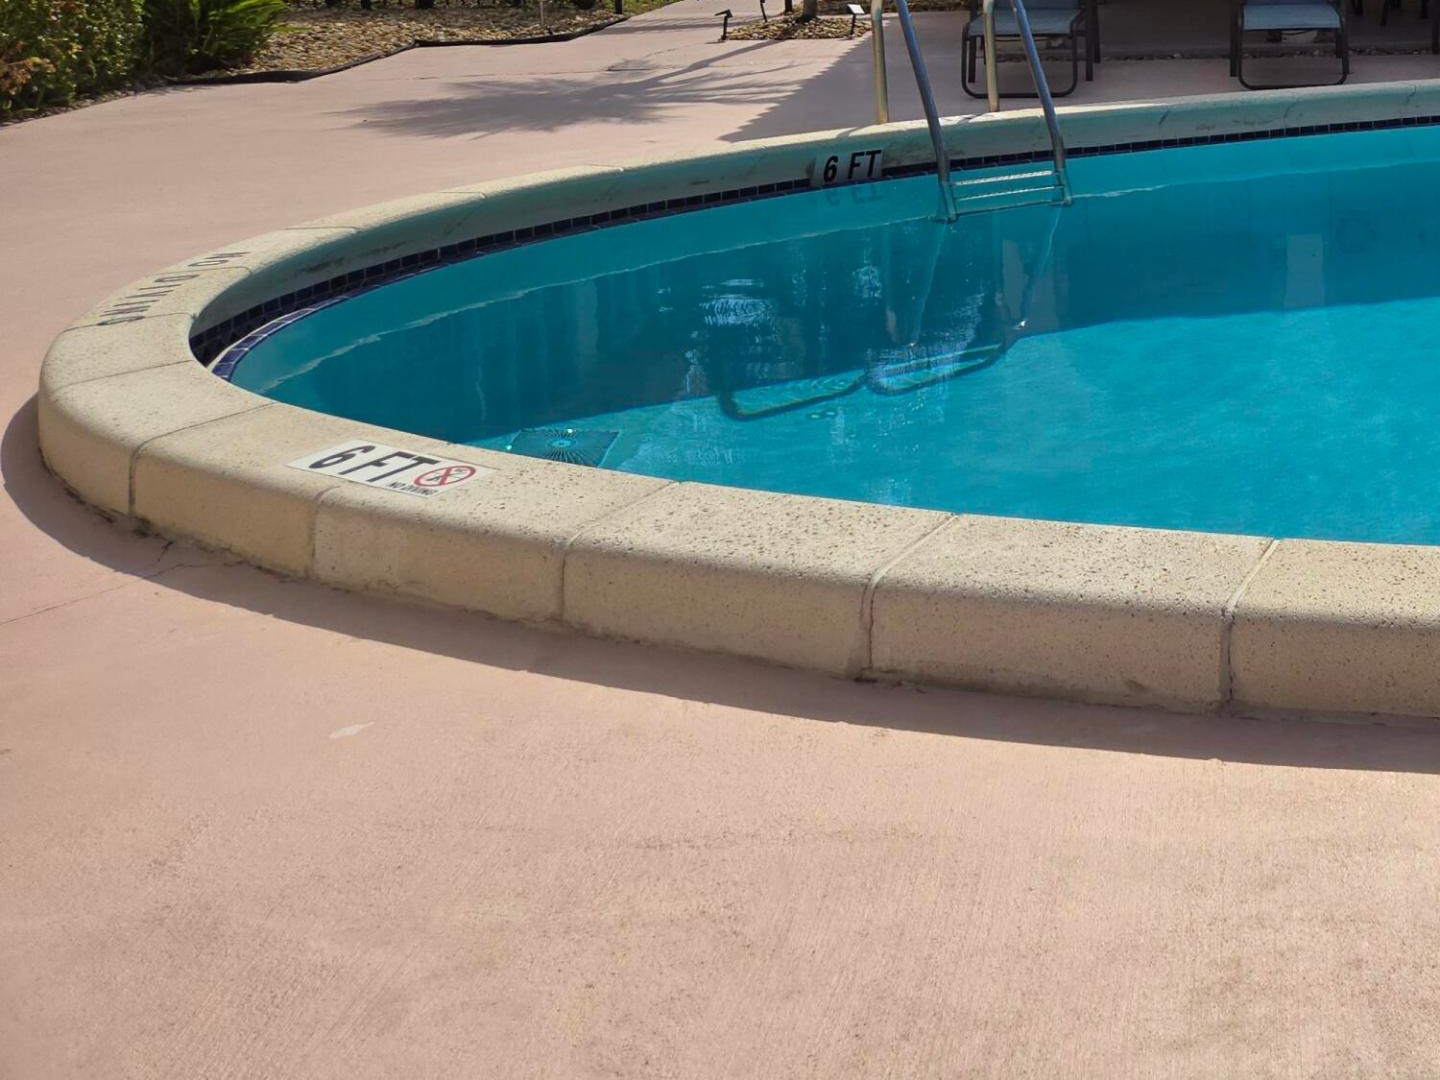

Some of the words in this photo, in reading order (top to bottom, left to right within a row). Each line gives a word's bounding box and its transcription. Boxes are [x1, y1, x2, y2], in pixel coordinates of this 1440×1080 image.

[823, 155, 839, 182] 6
[848, 149, 882, 179] FT
[308, 445, 376, 469] 6
[338, 451, 441, 483] FT
